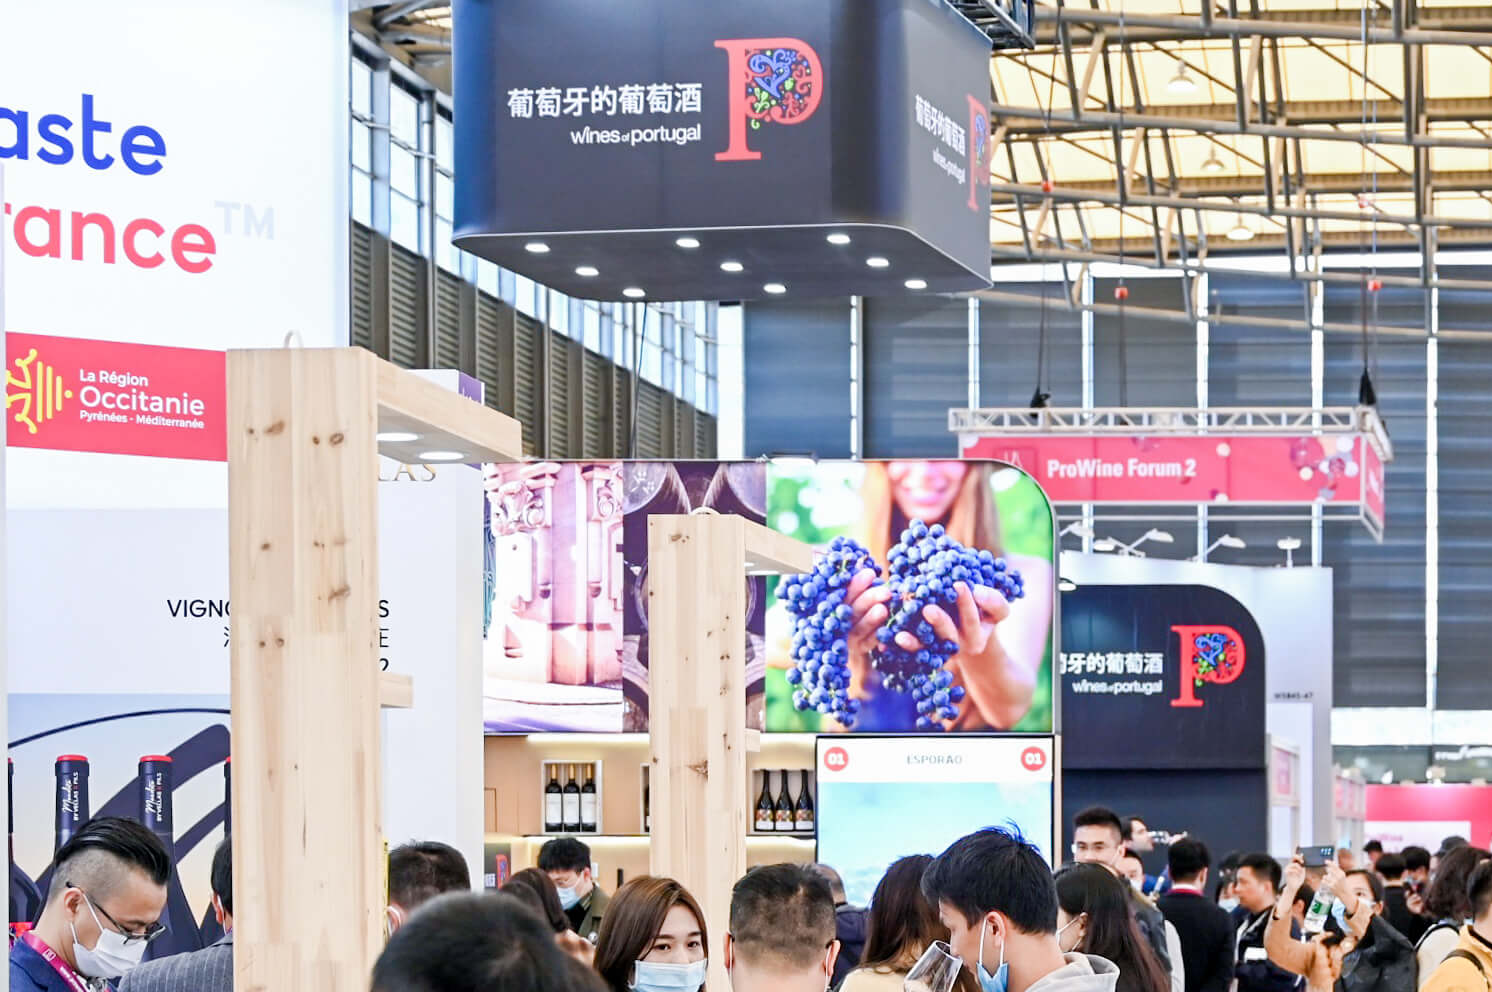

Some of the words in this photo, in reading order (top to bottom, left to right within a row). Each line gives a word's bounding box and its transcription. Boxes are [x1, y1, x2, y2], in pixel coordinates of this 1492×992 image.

[507, 82, 702, 118] 葡萄牙的葡萄酒
[570, 126, 620, 145] wines
[630, 123, 701, 146] portugal
[80, 369, 96, 382] La
[99, 370, 149, 388] Région
[80, 385, 205, 416] Occitanie
[1047, 458, 1123, 478] ProWine
[1127, 459, 1182, 477] Forum
[1185, 458, 1197, 477] 2
[827, 752, 846, 766] 01
[1024, 752, 1043, 766] 01
